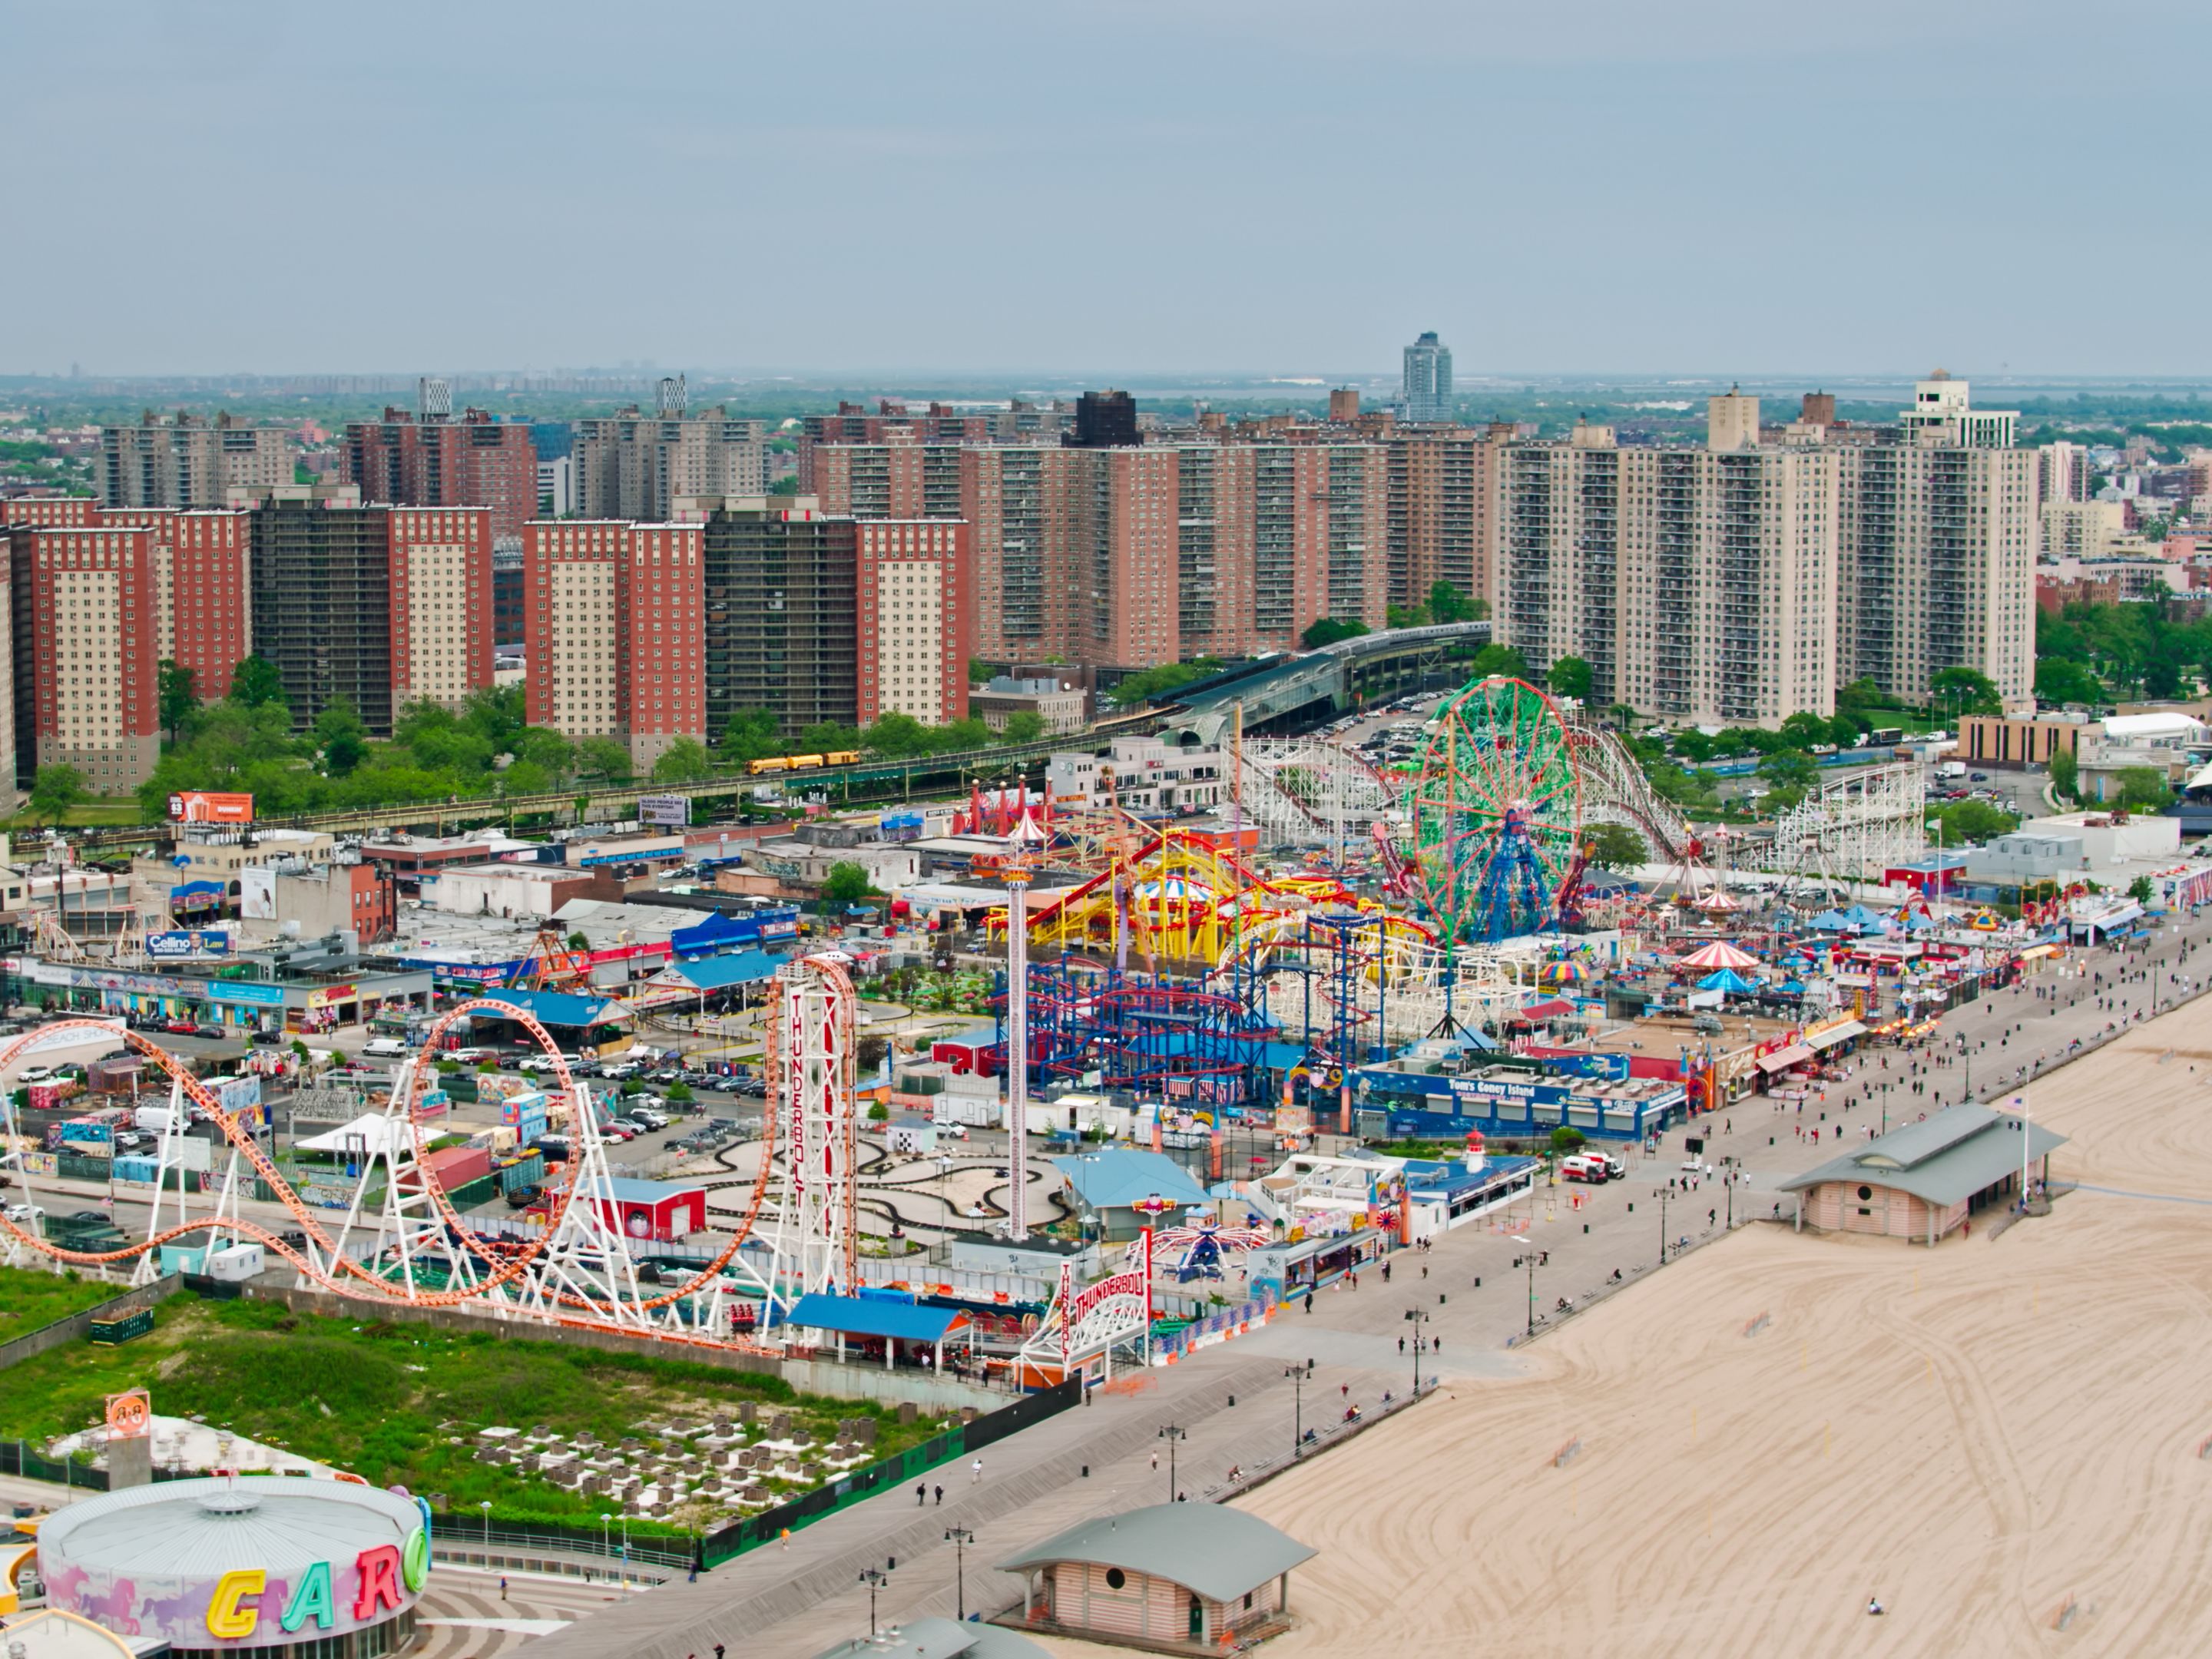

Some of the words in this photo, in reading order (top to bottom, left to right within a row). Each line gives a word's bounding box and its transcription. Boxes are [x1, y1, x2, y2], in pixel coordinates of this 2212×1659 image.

[150, 935, 190, 948] Cellino
[204, 939, 224, 948] Law
[46, 1031, 80, 1045] BEACH
[792, 995, 805, 1208] THUNDERBOLT
[1449, 1078, 1475, 1091] Tom's
[1478, 1081, 1506, 1096] Coney
[1508, 1084, 1535, 1098] Island
[1076, 1272, 1144, 1324] THUNDERBOLT
[207, 1525, 432, 1638] CARO
